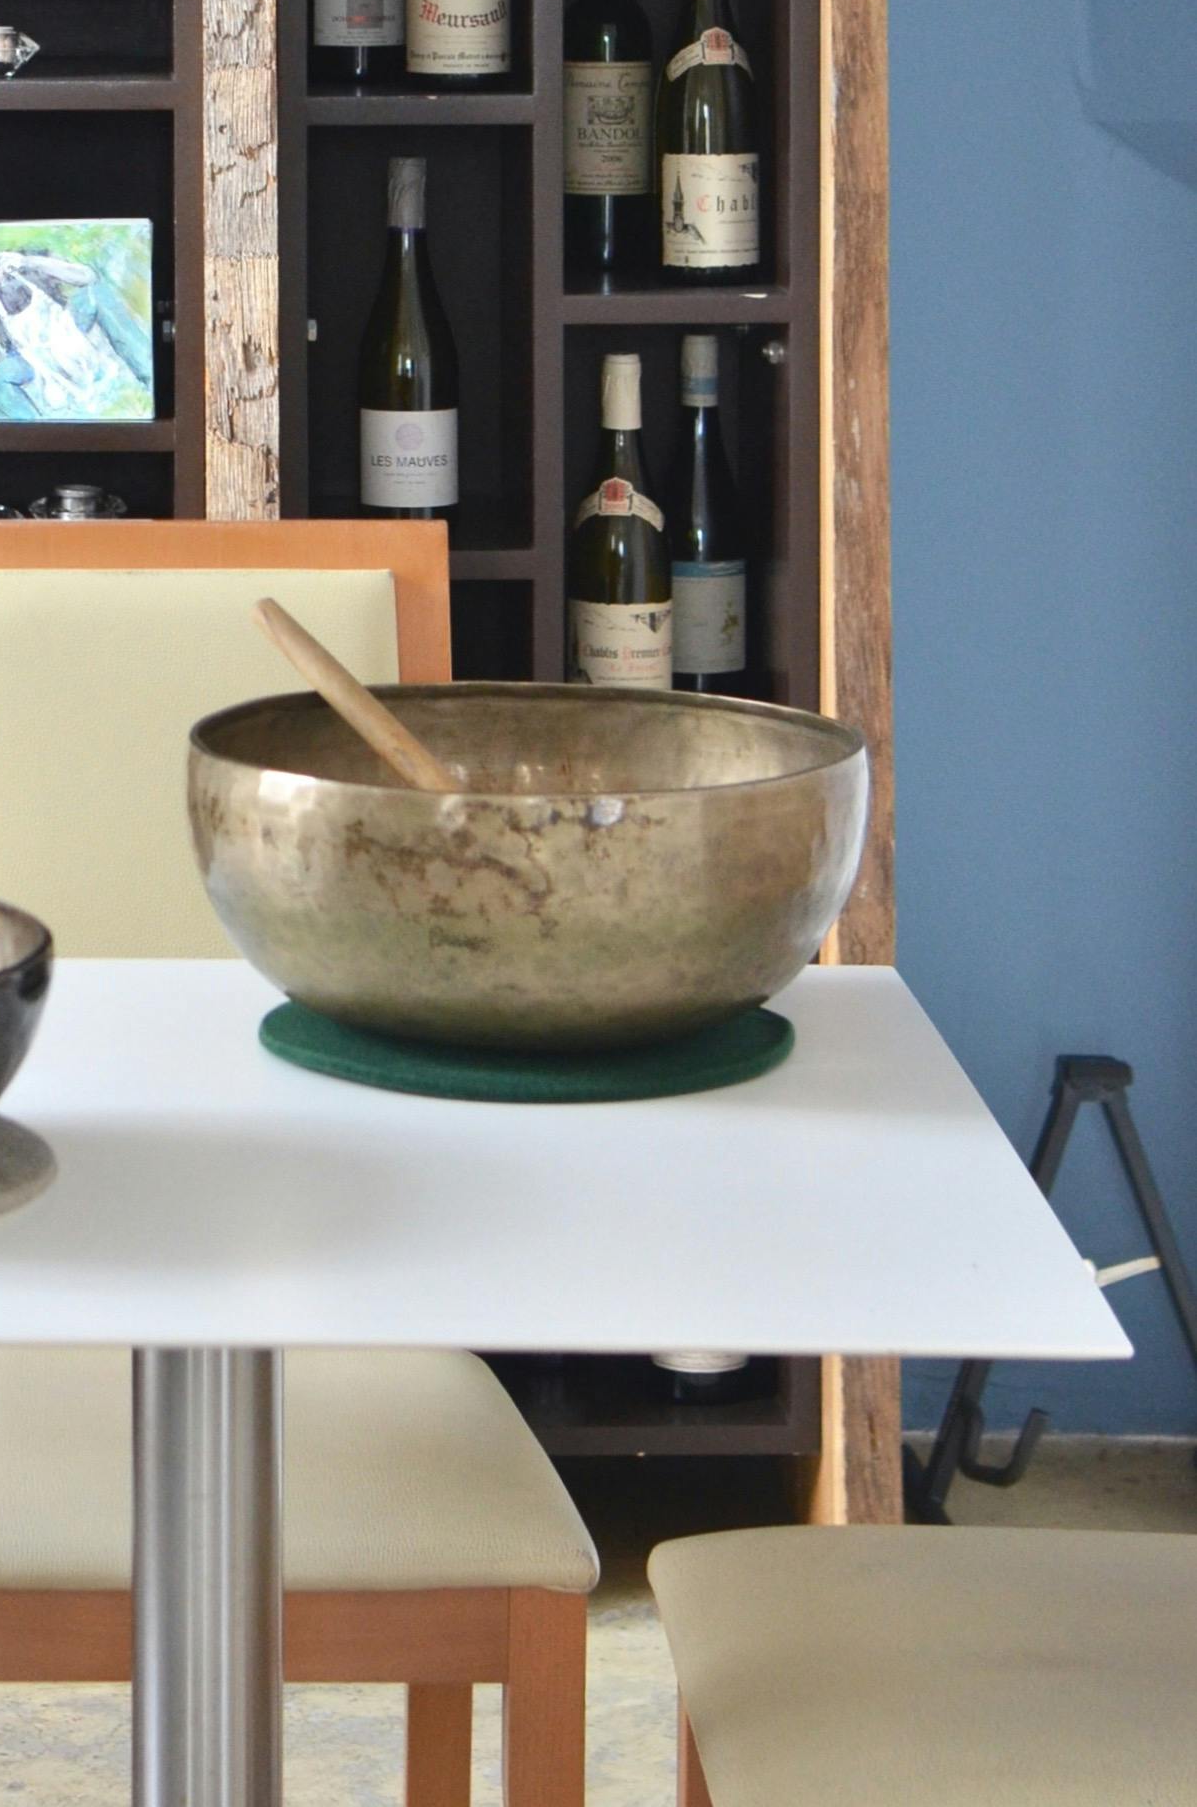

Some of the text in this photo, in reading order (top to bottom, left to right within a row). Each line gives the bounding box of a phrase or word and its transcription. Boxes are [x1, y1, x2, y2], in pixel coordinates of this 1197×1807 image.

[577, 127, 643, 140] BANDOL
[371, 454, 448, 468] LES MAUVES
